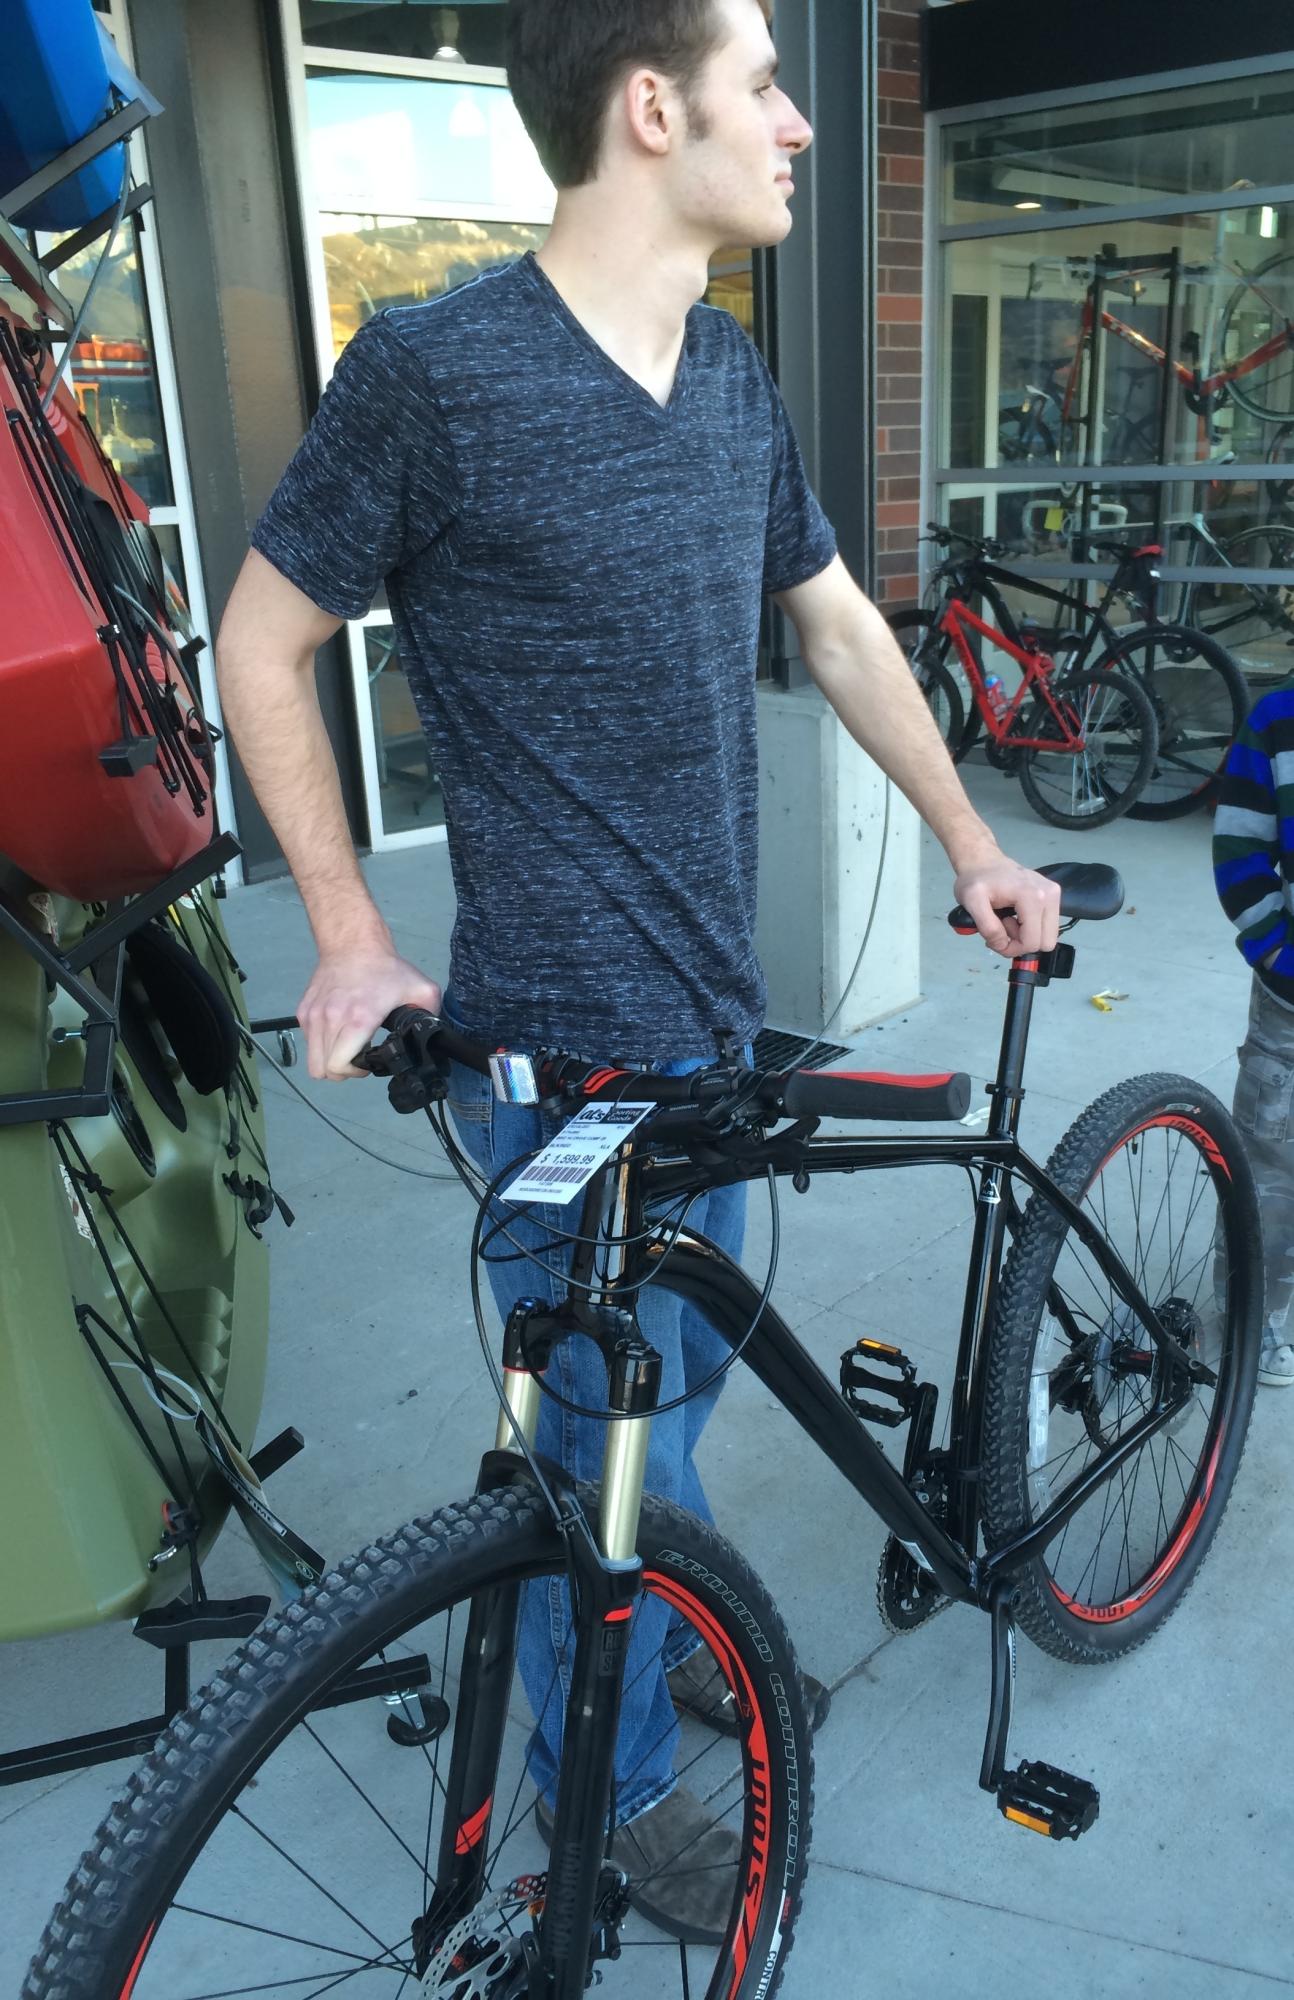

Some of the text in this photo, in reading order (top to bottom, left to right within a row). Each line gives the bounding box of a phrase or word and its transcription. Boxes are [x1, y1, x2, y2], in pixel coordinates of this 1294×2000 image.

[553, 1153, 596, 1165] 1,599.99
[655, 1549, 800, 1887] GROUND CONTROL
[745, 1759, 767, 1907] STOUT
[755, 1951, 778, 2000] CONTR
